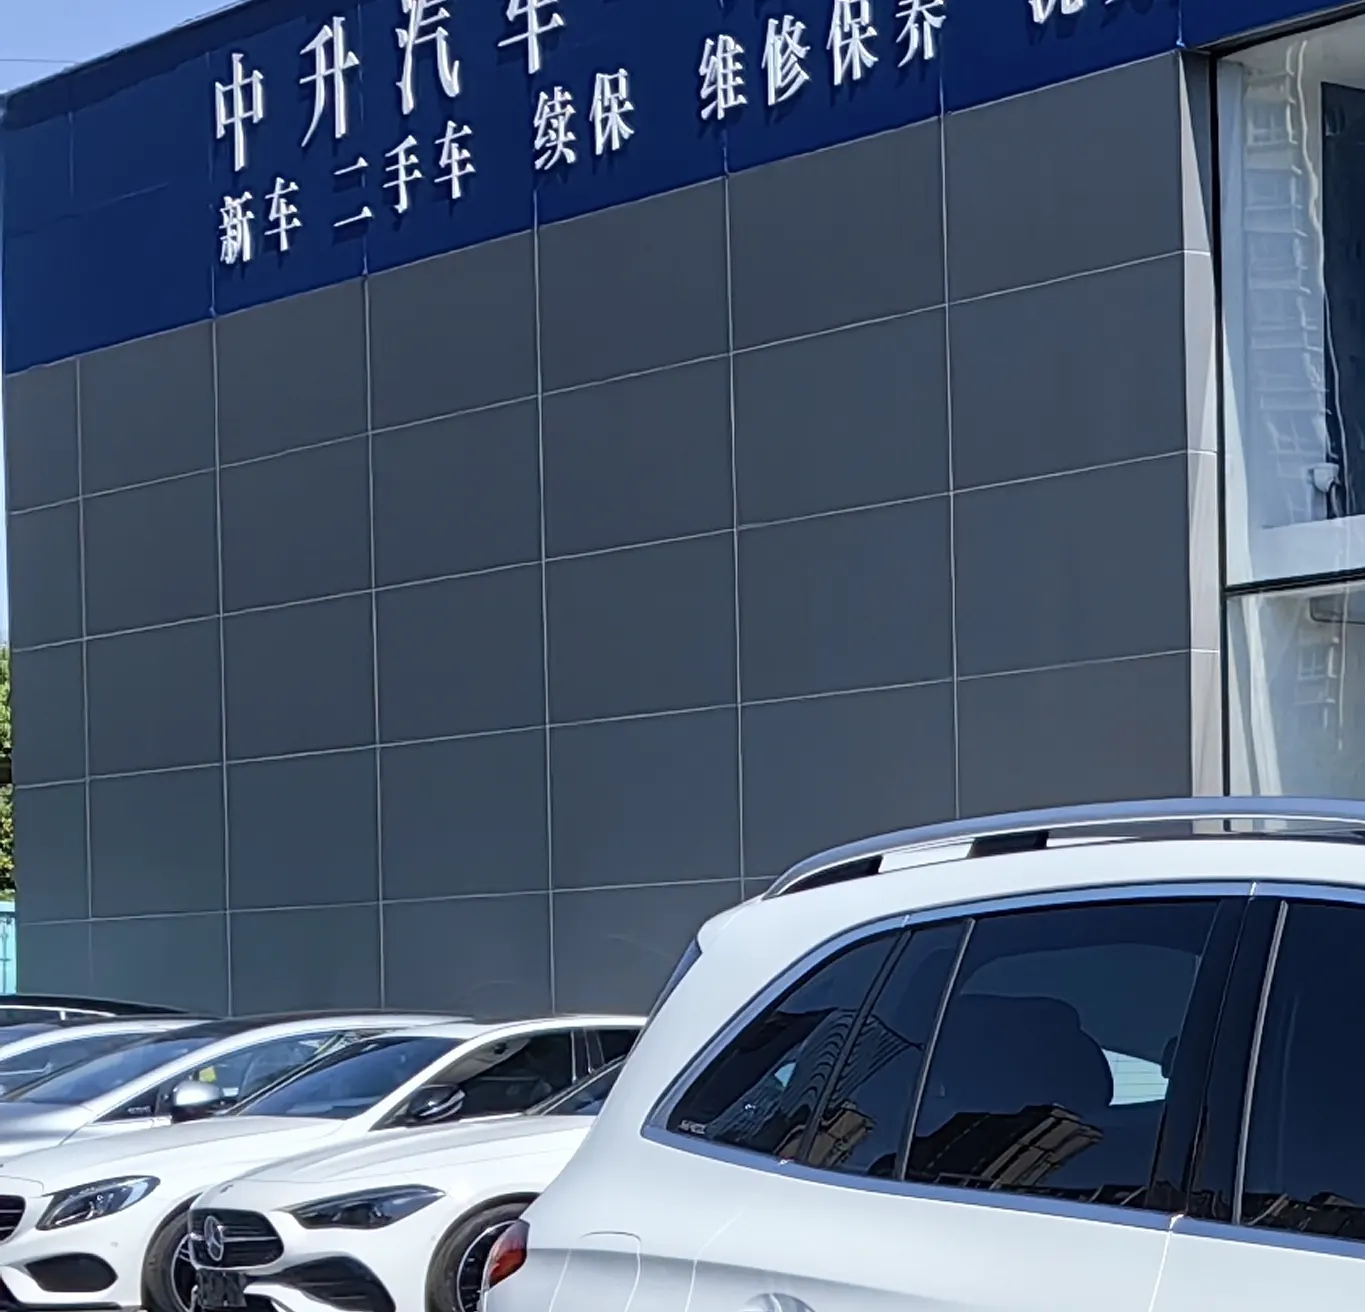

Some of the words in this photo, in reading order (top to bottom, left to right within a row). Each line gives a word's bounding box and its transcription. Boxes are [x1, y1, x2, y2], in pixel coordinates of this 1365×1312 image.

[214, 0, 565, 172] 中升汽车
[218, 176, 302, 265] 新车
[332, 119, 476, 228] 二手车
[532, 67, 634, 170] 续保
[697, 0, 946, 121] 维修保养
